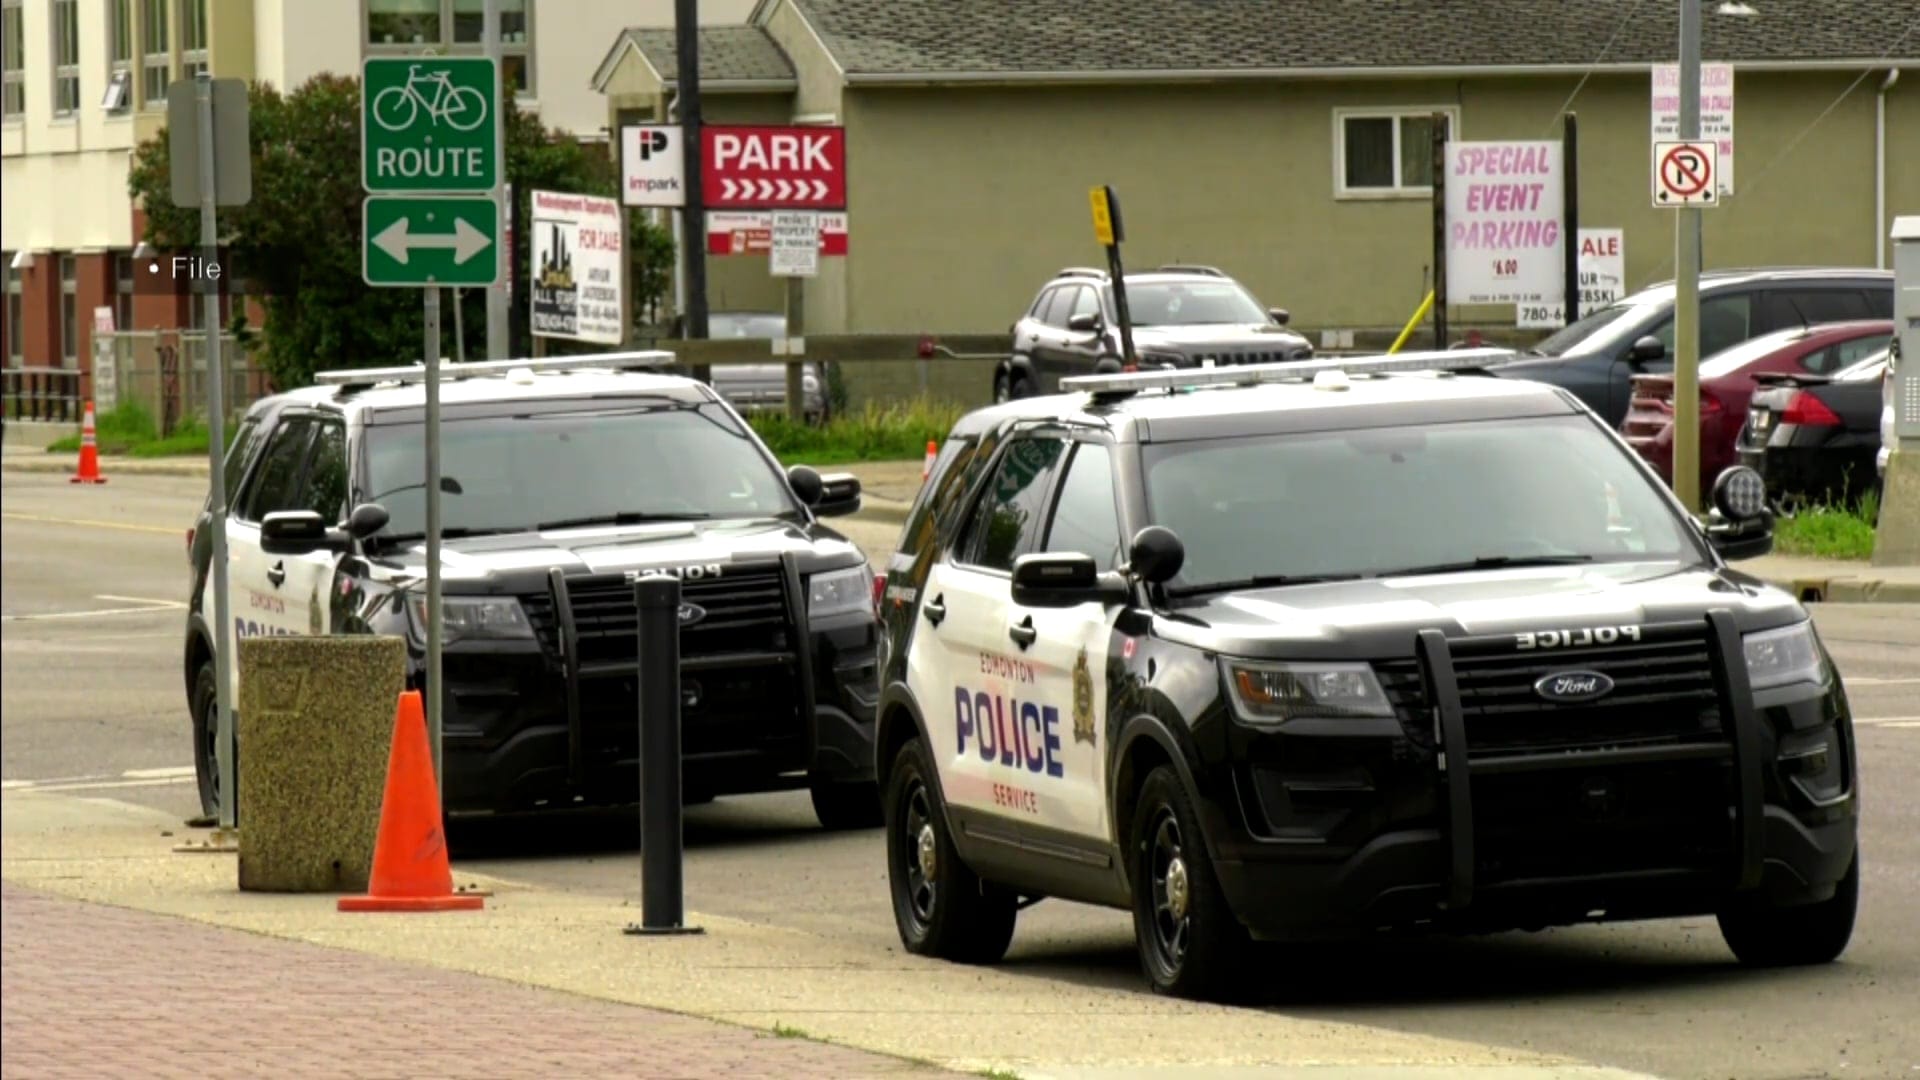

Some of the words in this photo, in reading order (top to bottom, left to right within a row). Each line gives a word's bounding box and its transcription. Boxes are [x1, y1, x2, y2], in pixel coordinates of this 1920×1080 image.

[377, 147, 484, 177] ROUTE
[714, 135, 832, 171] PARK
[1455, 145, 1549, 176] SPECIAL
[630, 176, 678, 192] impark
[1466, 184, 1544, 212] EVENT
[579, 229, 596, 249] FOR
[1452, 220, 1558, 250] PARKING
[1581, 237, 1618, 256] ALE
[980, 653, 1035, 684] EDMONTON
[1554, 678, 1597, 694] Ford
[955, 686, 1063, 778] POLICE
[993, 783, 1038, 814] SERVICE
